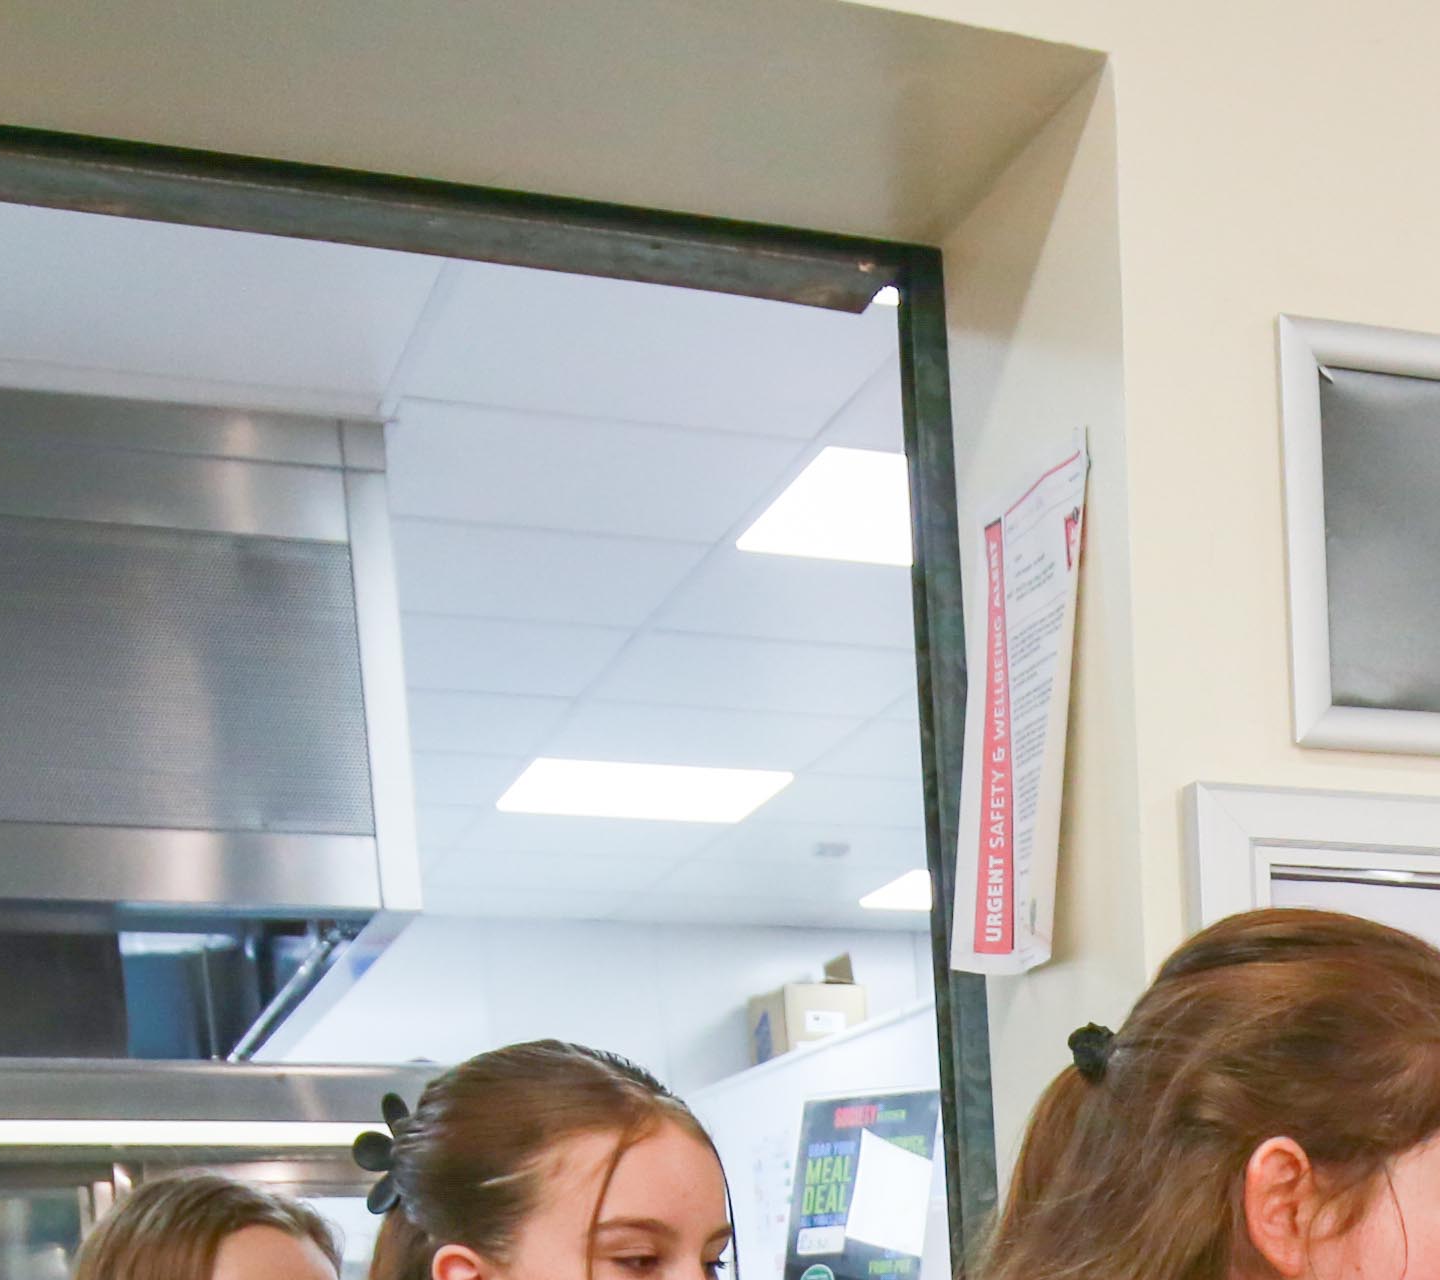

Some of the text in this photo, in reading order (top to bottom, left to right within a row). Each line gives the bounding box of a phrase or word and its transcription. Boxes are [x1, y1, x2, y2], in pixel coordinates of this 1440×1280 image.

[991, 617, 1008, 743] WELLBEING
[989, 769, 1006, 852] SAFETY
[985, 859, 1004, 943] URGENT
[802, 1184, 849, 1216] DEAL
[806, 1156, 852, 1183] MEAL
